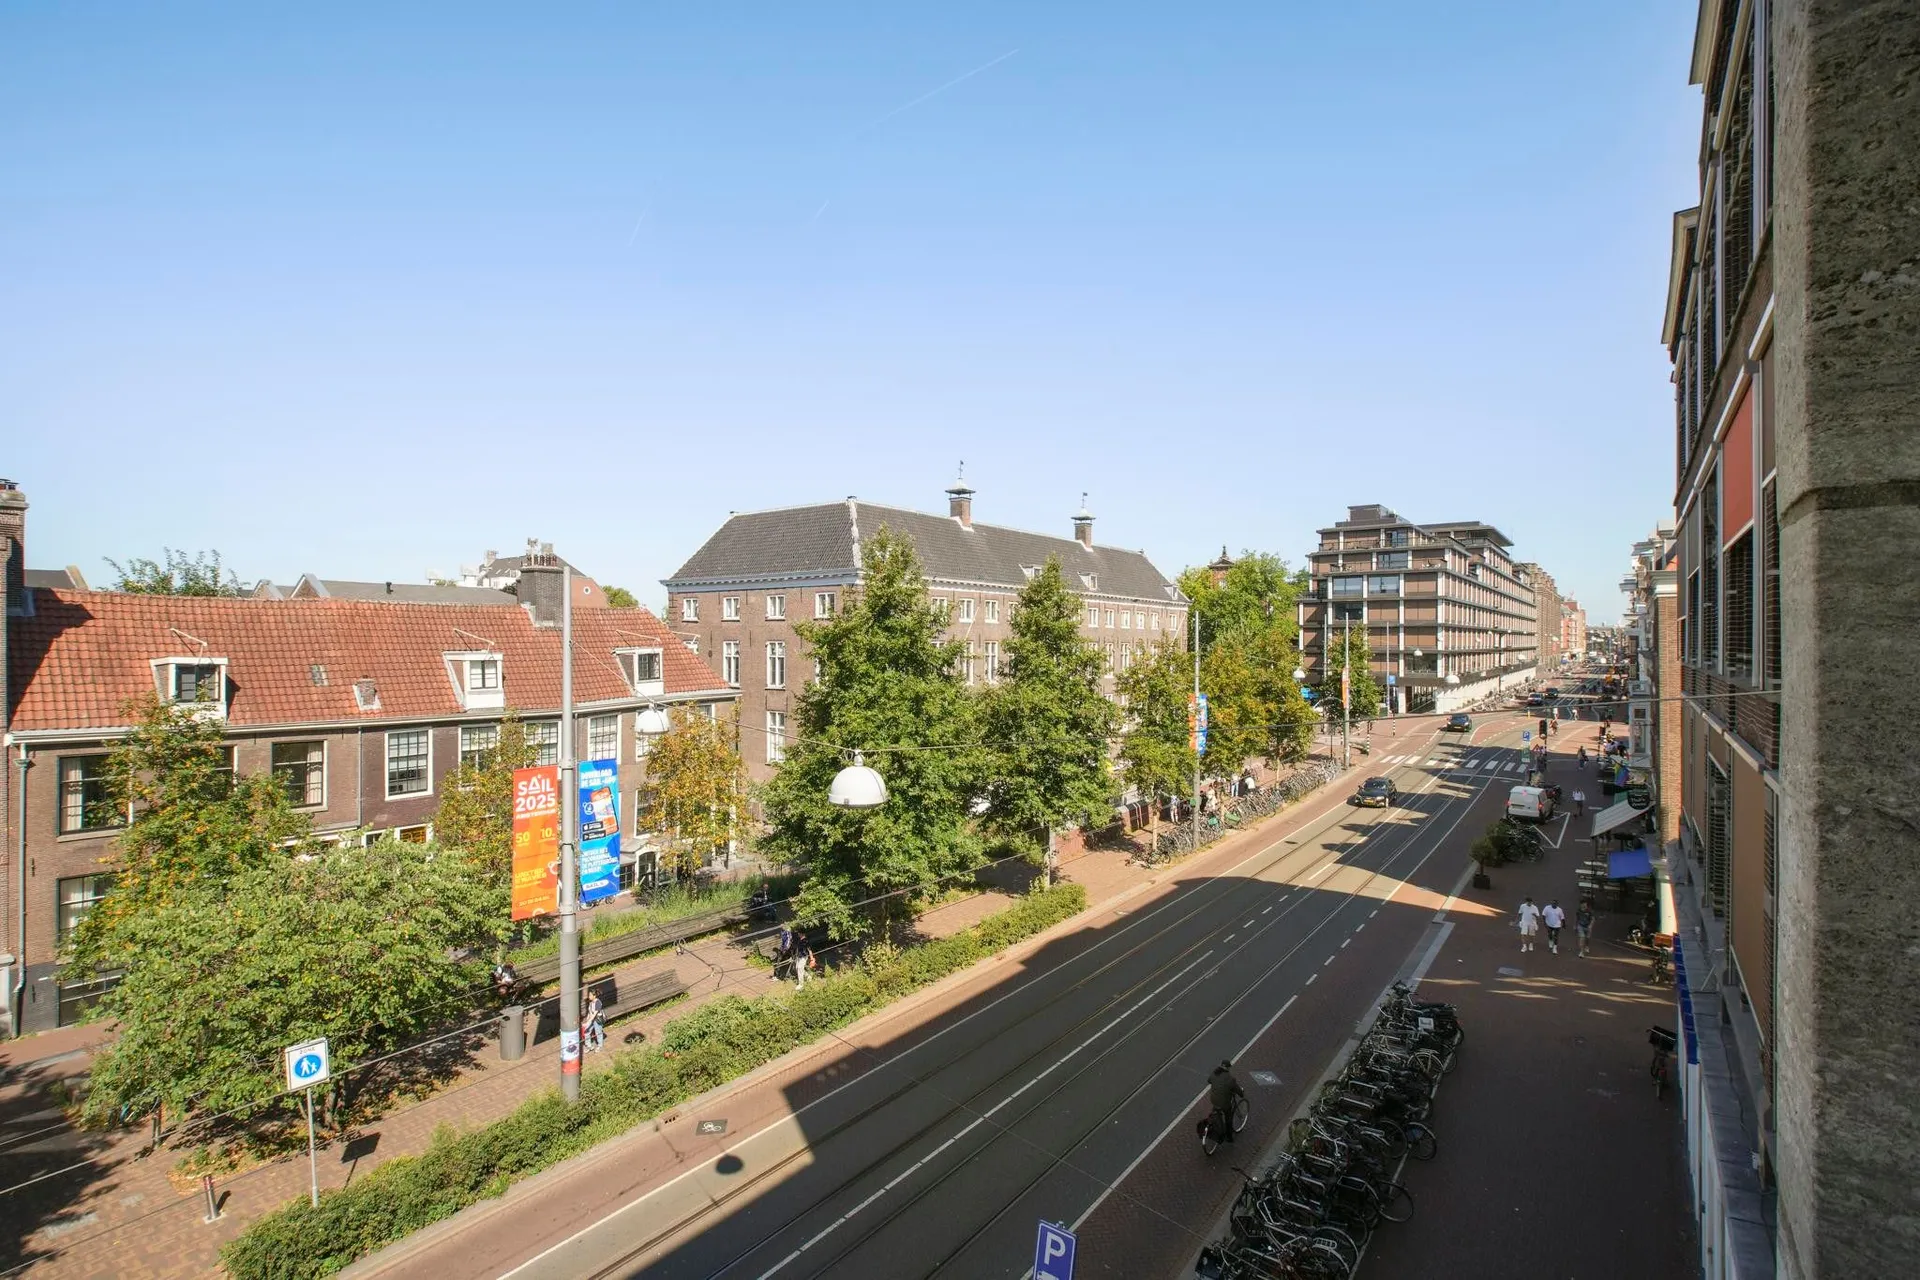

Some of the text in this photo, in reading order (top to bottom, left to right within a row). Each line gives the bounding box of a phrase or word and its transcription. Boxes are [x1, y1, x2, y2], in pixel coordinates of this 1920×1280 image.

[517, 775, 555, 796] SAIL
[515, 793, 556, 812] 2025
[516, 831, 530, 844] 50
[1044, 1231, 1066, 1265] P
